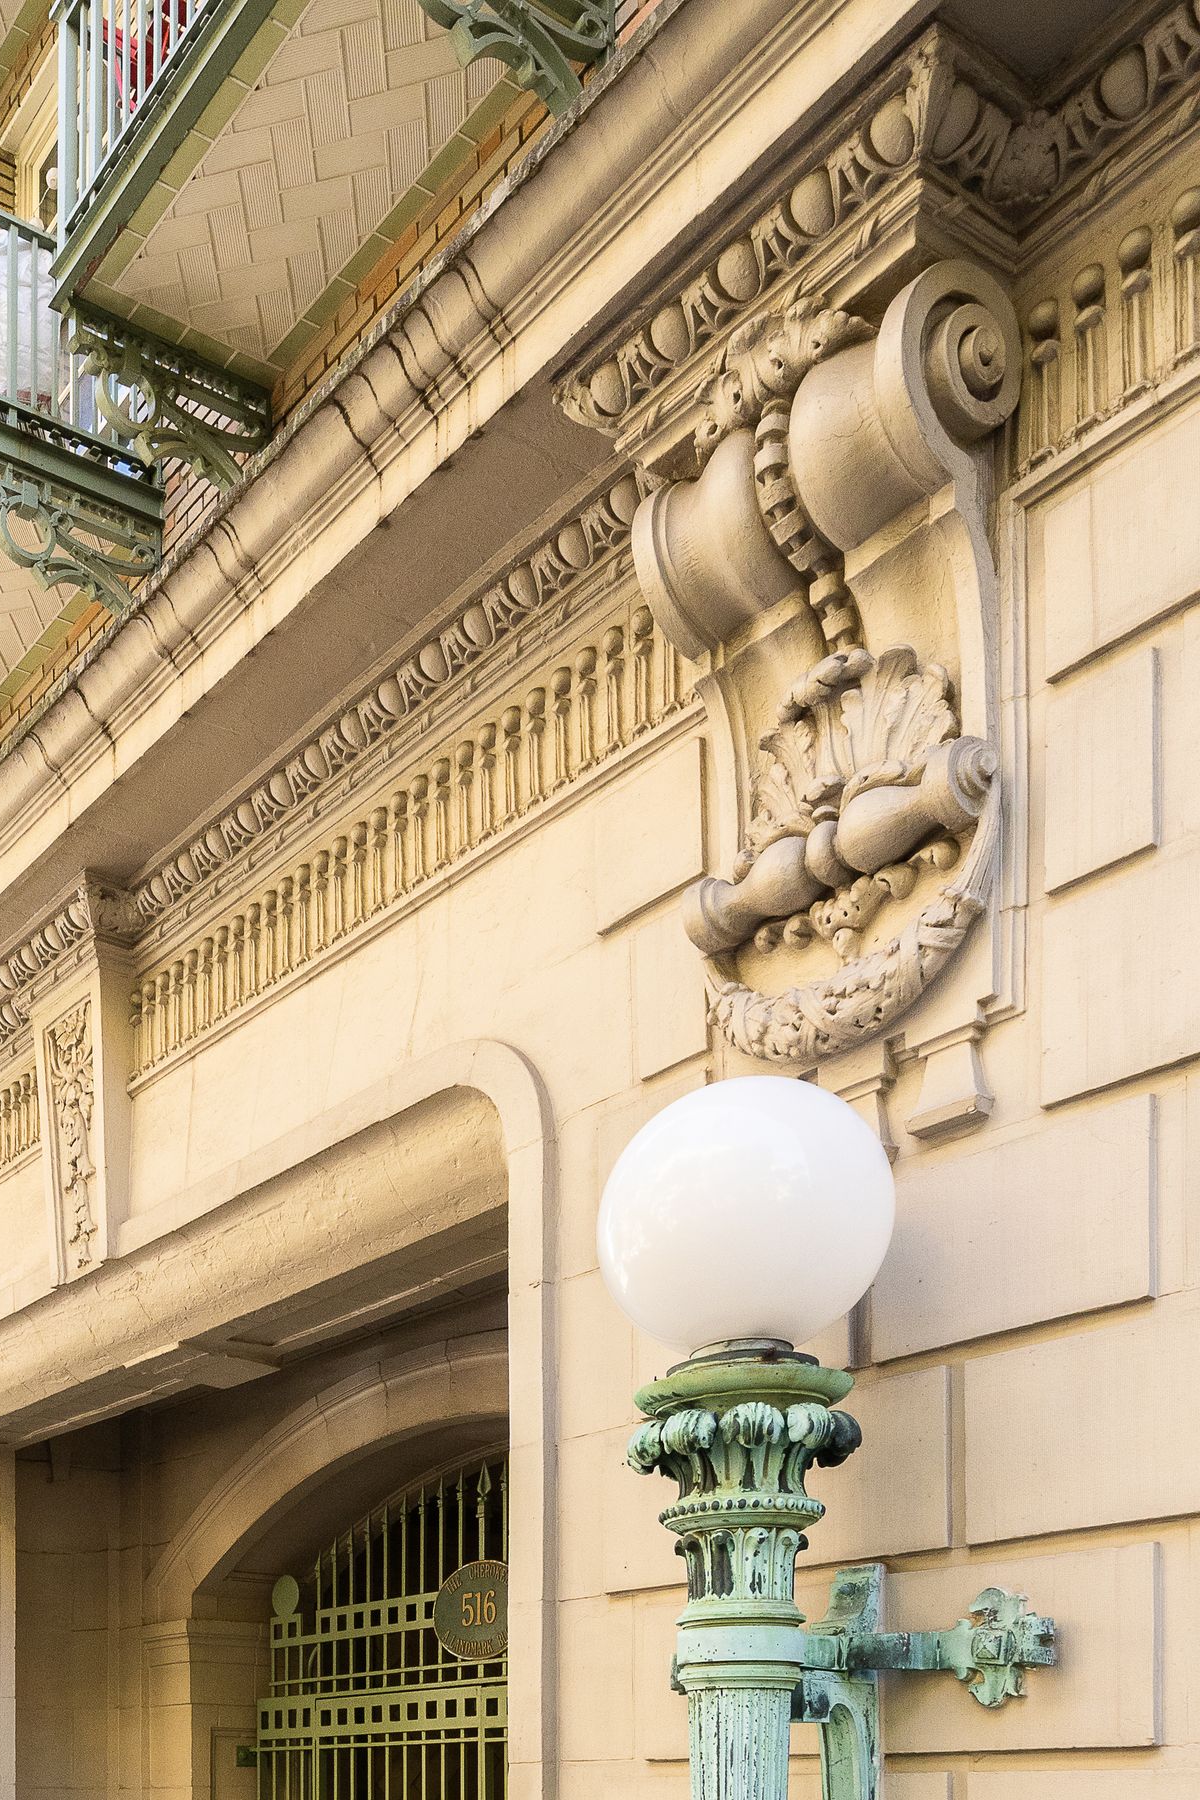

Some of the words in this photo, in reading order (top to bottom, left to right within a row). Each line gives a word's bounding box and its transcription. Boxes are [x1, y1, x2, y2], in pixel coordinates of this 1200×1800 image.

[446, 1573, 462, 1595] THE
[462, 1590, 496, 1626] 516
[441, 1630, 451, 1648] A
[450, 1635, 494, 1655] LANDMARK
